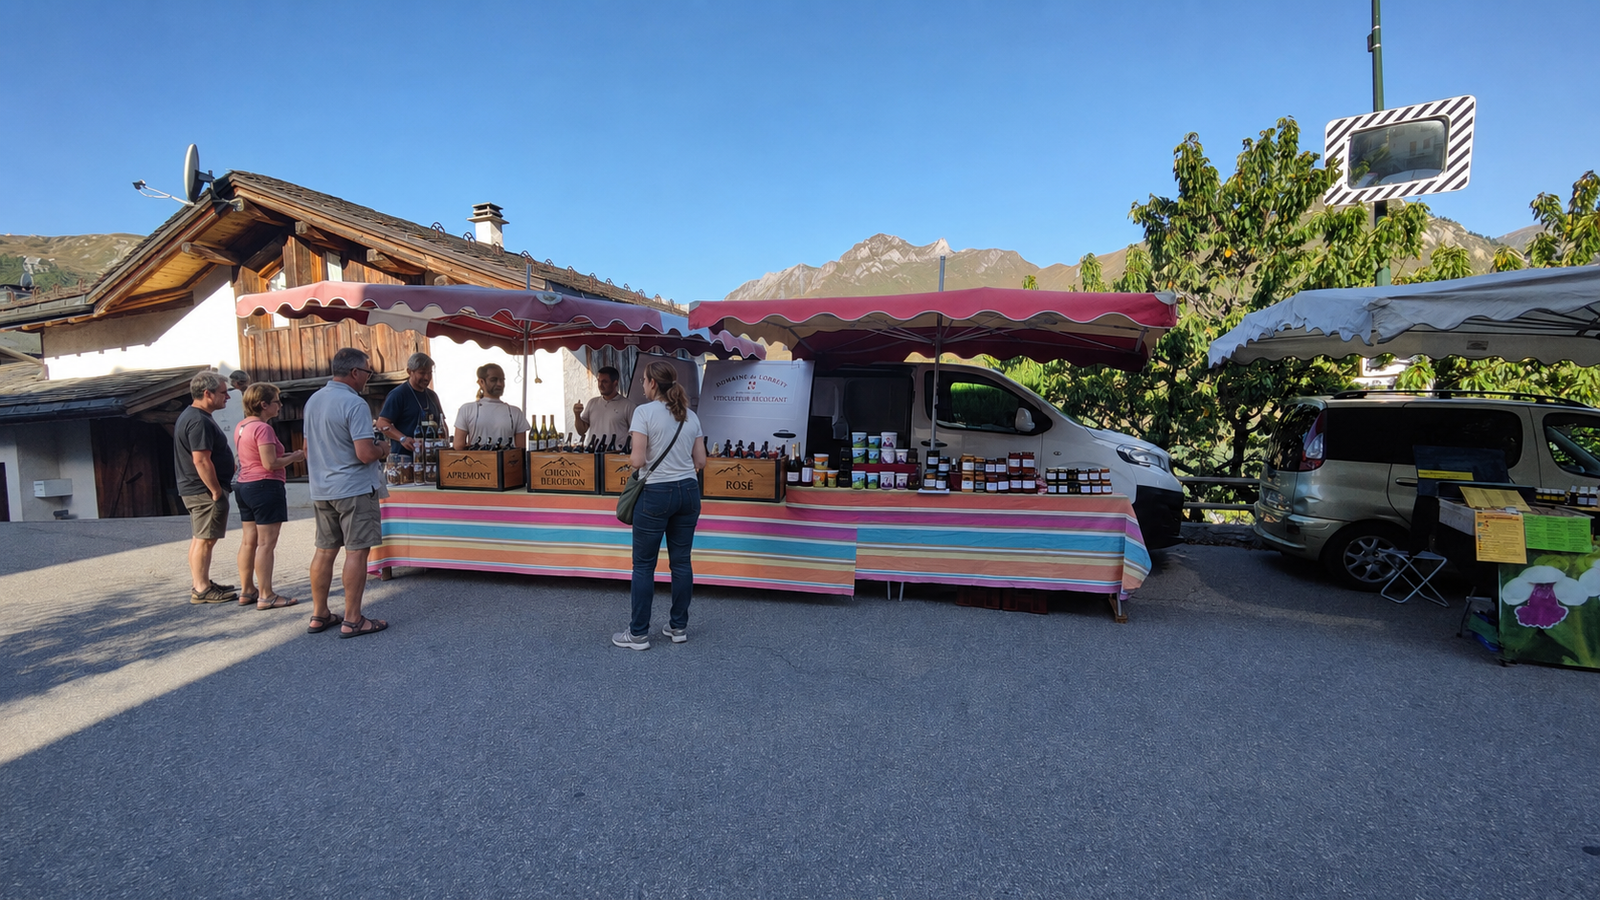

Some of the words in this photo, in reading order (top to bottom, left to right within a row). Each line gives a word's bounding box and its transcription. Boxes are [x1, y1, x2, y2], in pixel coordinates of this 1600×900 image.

[715, 374, 748, 388] DOMAINE
[446, 471, 491, 480] APREMONT
[540, 477, 586, 486] BERGERON
[725, 479, 754, 491] ROSÉ
